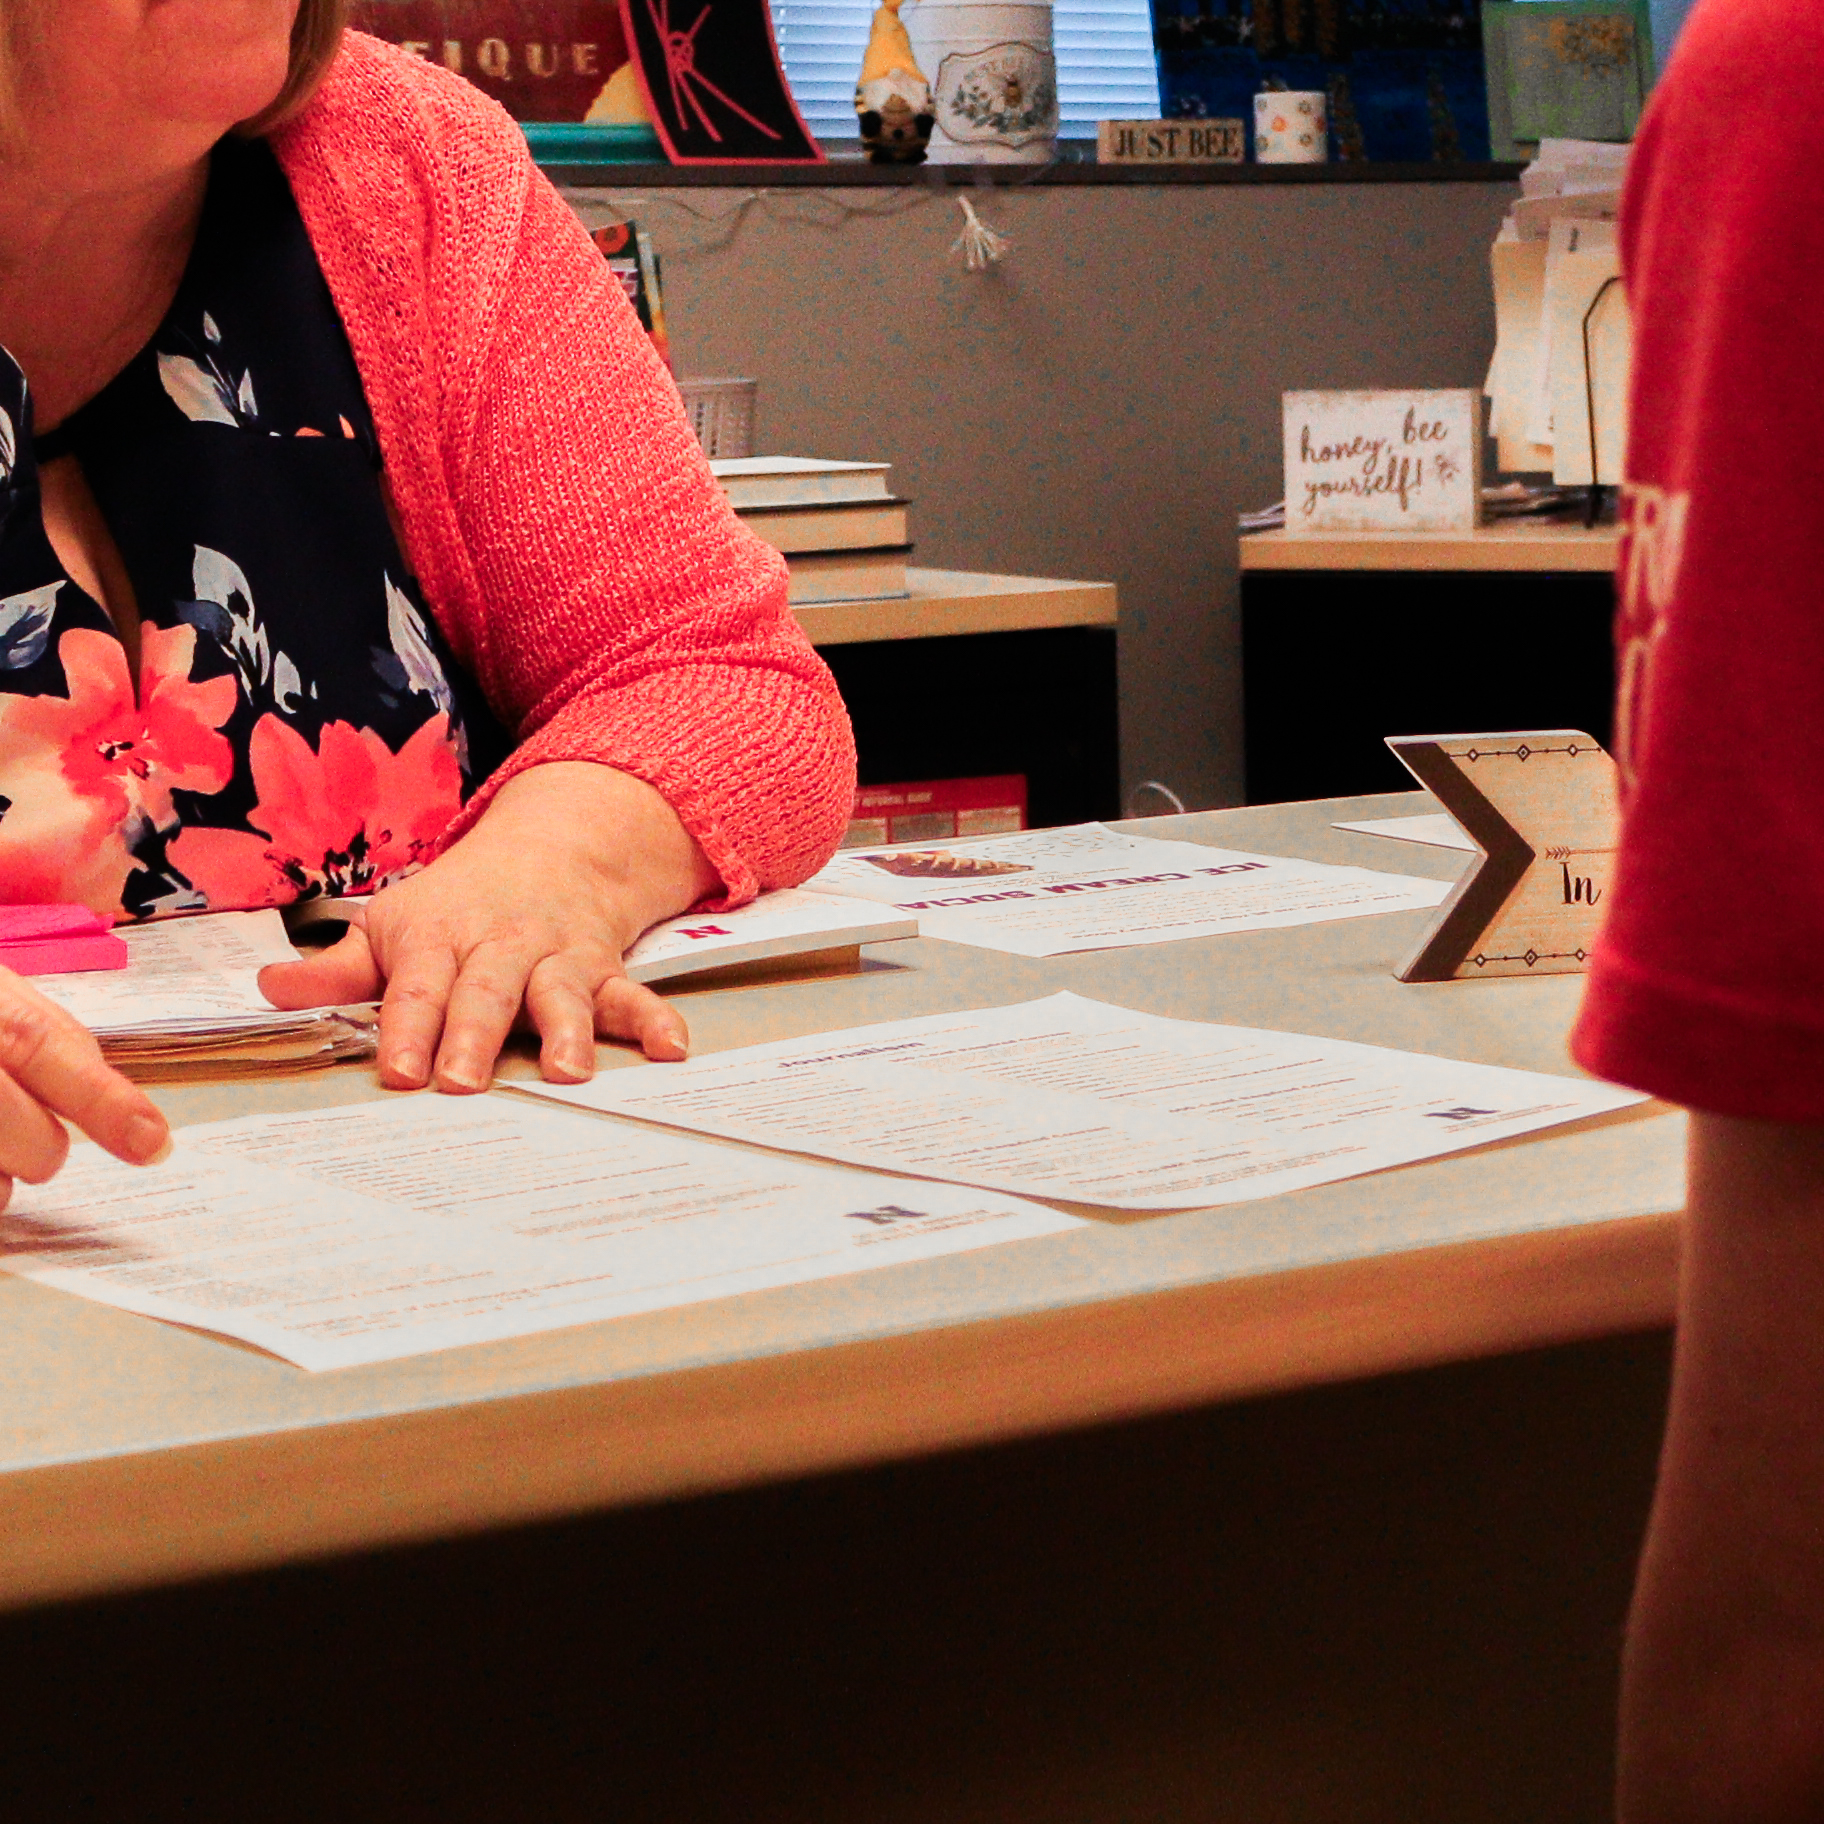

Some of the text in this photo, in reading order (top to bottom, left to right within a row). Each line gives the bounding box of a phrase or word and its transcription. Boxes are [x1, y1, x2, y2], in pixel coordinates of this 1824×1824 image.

[1114, 124, 1240, 158] JUST BEE
[1300, 404, 1448, 478] honey, bee
[1304, 455, 1424, 515] yourself!
[1041, 872, 1191, 894] CREAM
[1193, 861, 1272, 875] ICE
[1558, 861, 1602, 906] In
[894, 890, 1036, 912] SOCIA
[776, 1041, 926, 1069] Journalism
